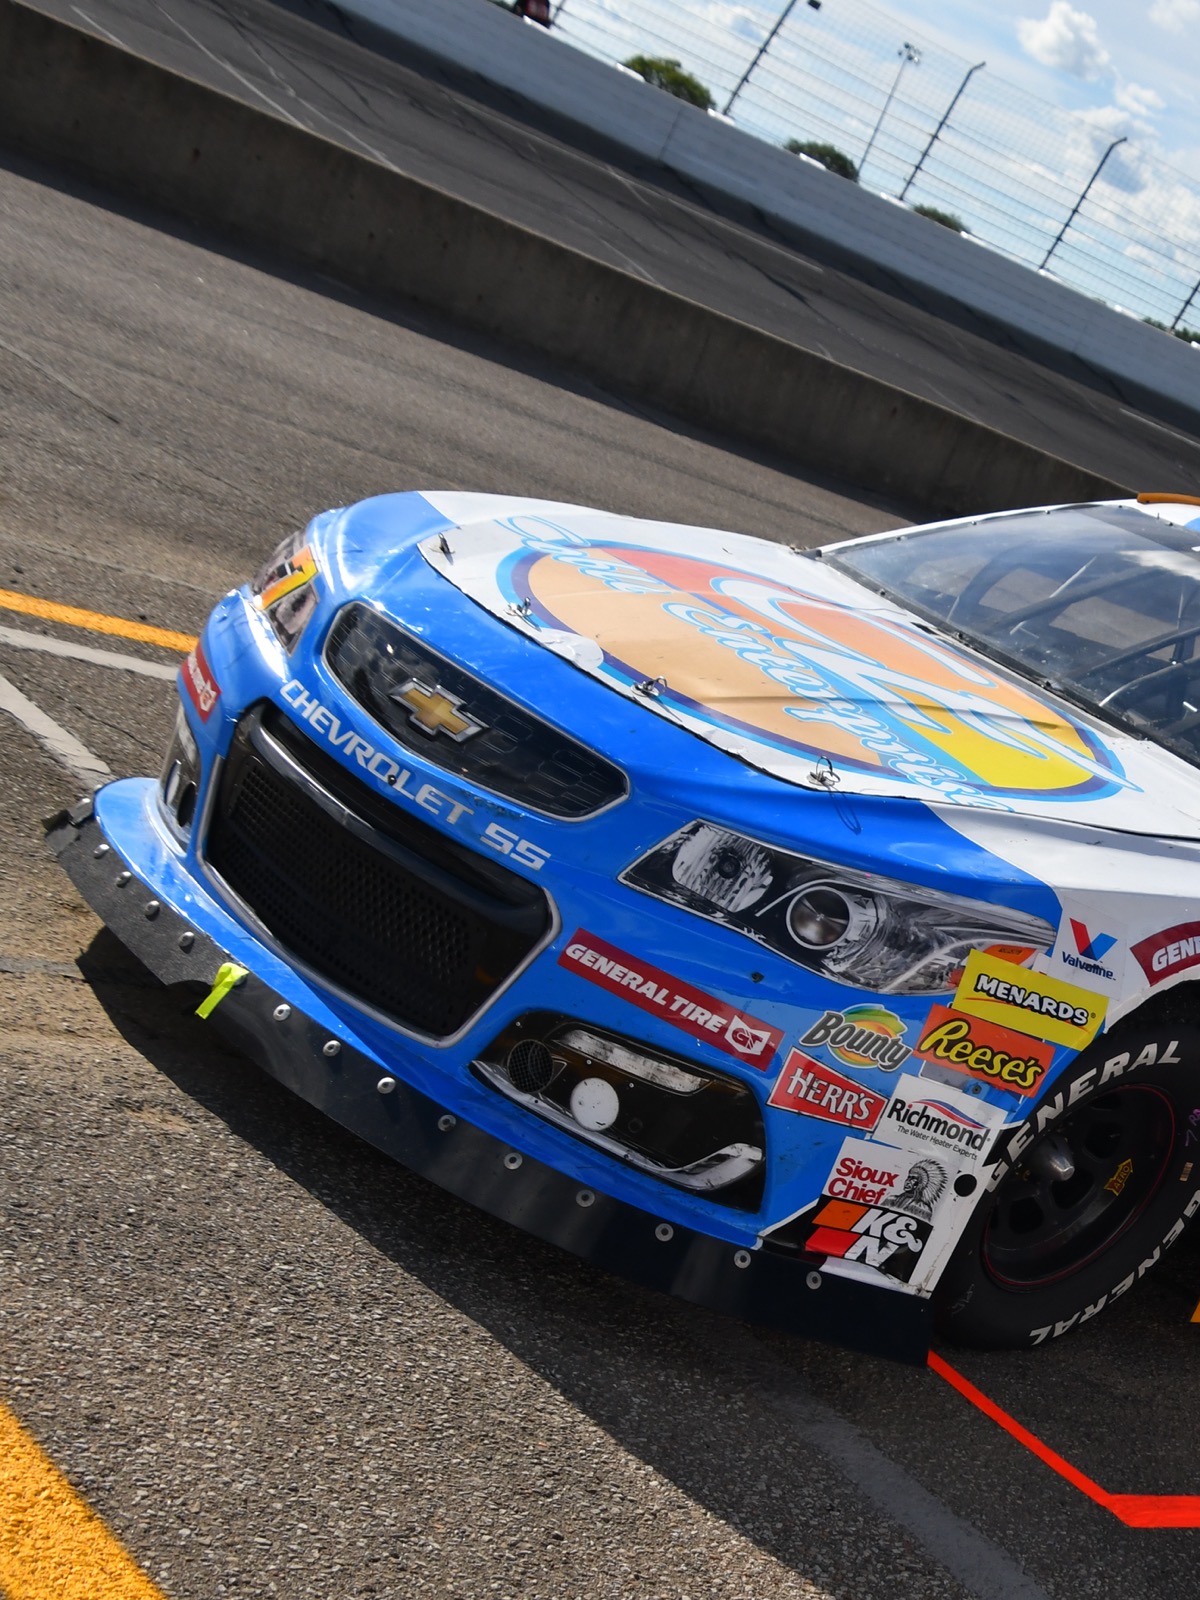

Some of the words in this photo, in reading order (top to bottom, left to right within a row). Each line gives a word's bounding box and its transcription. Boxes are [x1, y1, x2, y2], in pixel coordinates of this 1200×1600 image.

[280, 679, 475, 825] CHEVROLET
[481, 823, 552, 871] SS
[565, 943, 668, 1007] GENERAL
[666, 998, 728, 1033] TIRE
[974, 973, 1089, 1026] MENARDS
[801, 1010, 914, 1072] Bounty
[920, 1018, 1046, 1090] Reese's
[887, 1098, 991, 1152] Richmond
[897, 1125, 909, 1135] The
[909, 1129, 930, 1141] Water
[930, 1136, 953, 1152] Heater
[953, 1145, 978, 1160] Experts
[985, 1040, 1182, 1193] GENERAL
[827, 1177, 887, 1205] Chief
[836, 1157, 900, 1188] Sioux
[1113, 1163, 1131, 1191] AERO
